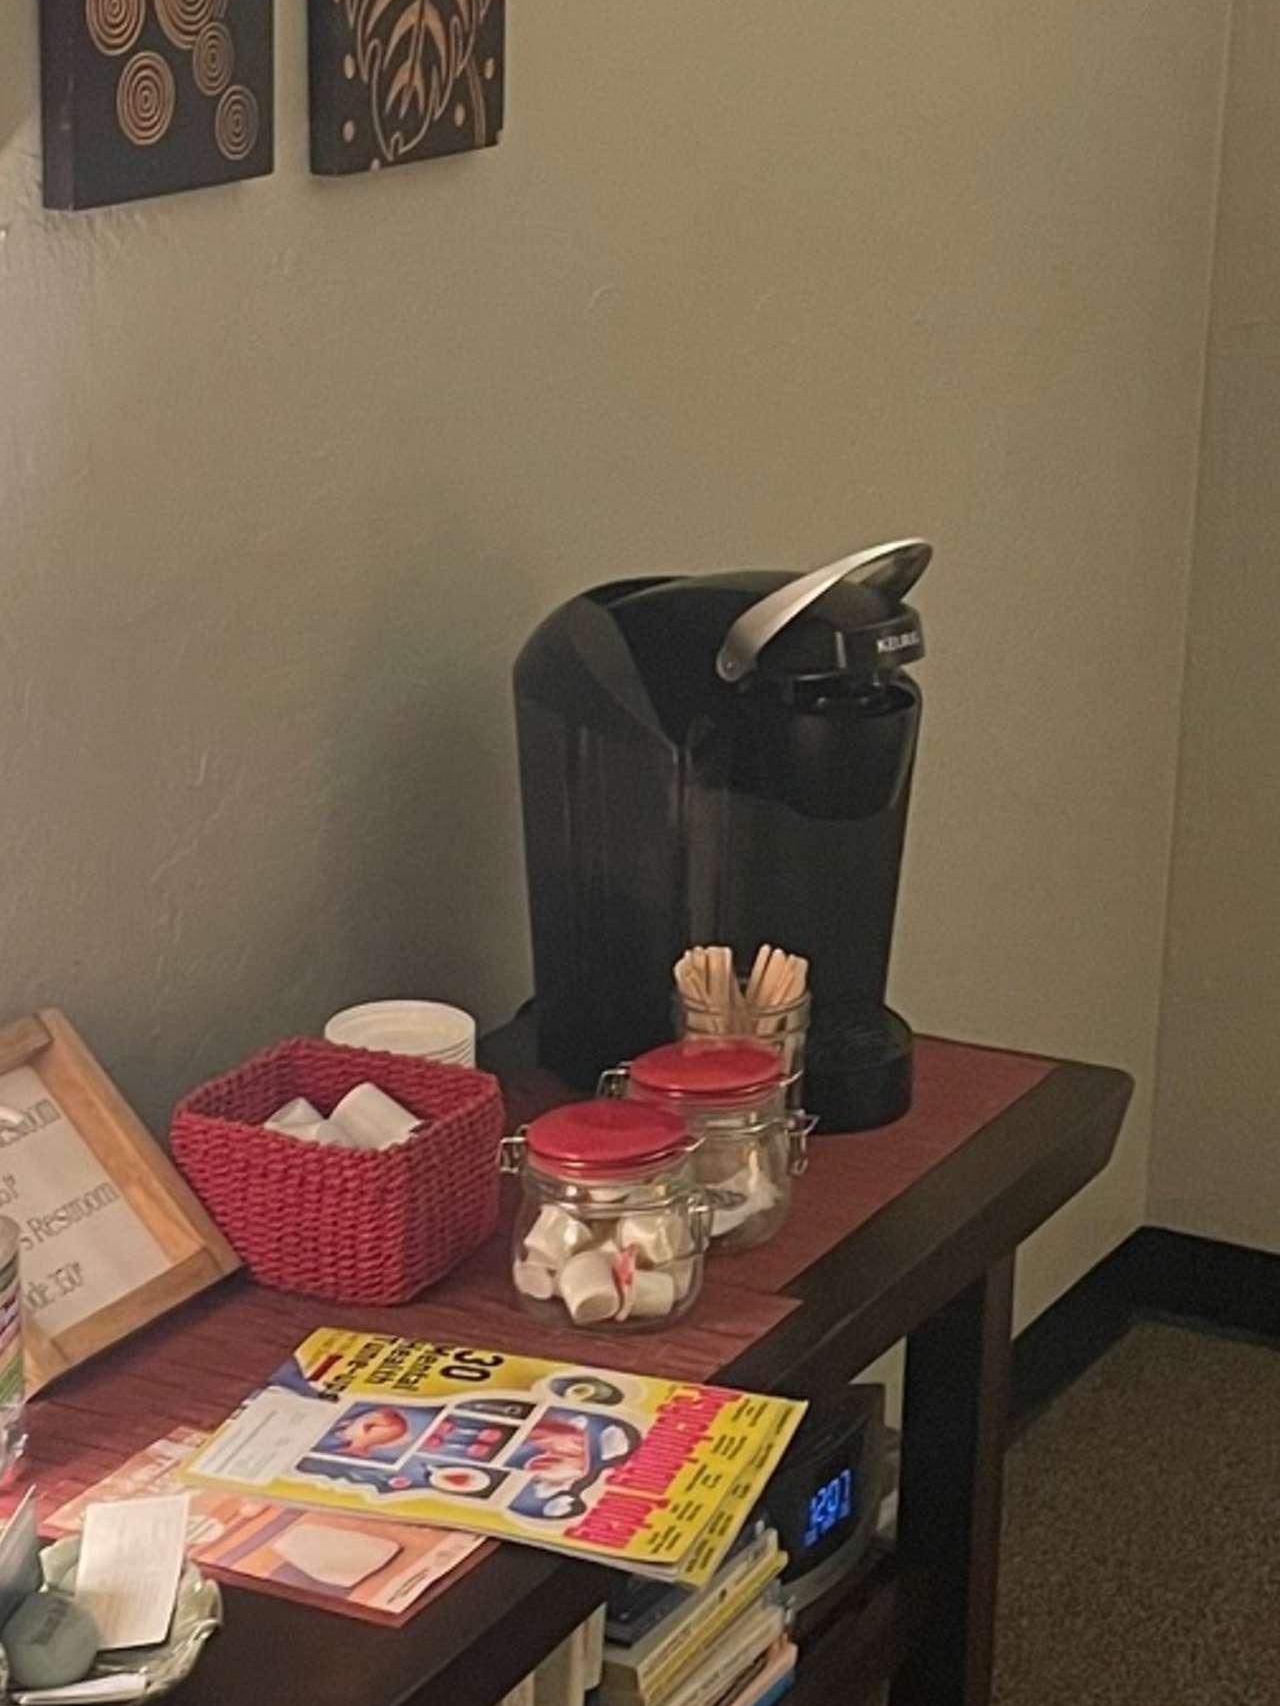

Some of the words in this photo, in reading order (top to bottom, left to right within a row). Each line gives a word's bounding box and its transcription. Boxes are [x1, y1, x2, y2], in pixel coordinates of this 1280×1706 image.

[439, 1349, 506, 1383] 30
[605, 1385, 744, 1494] Psychology
[563, 1489, 672, 1549] Today
